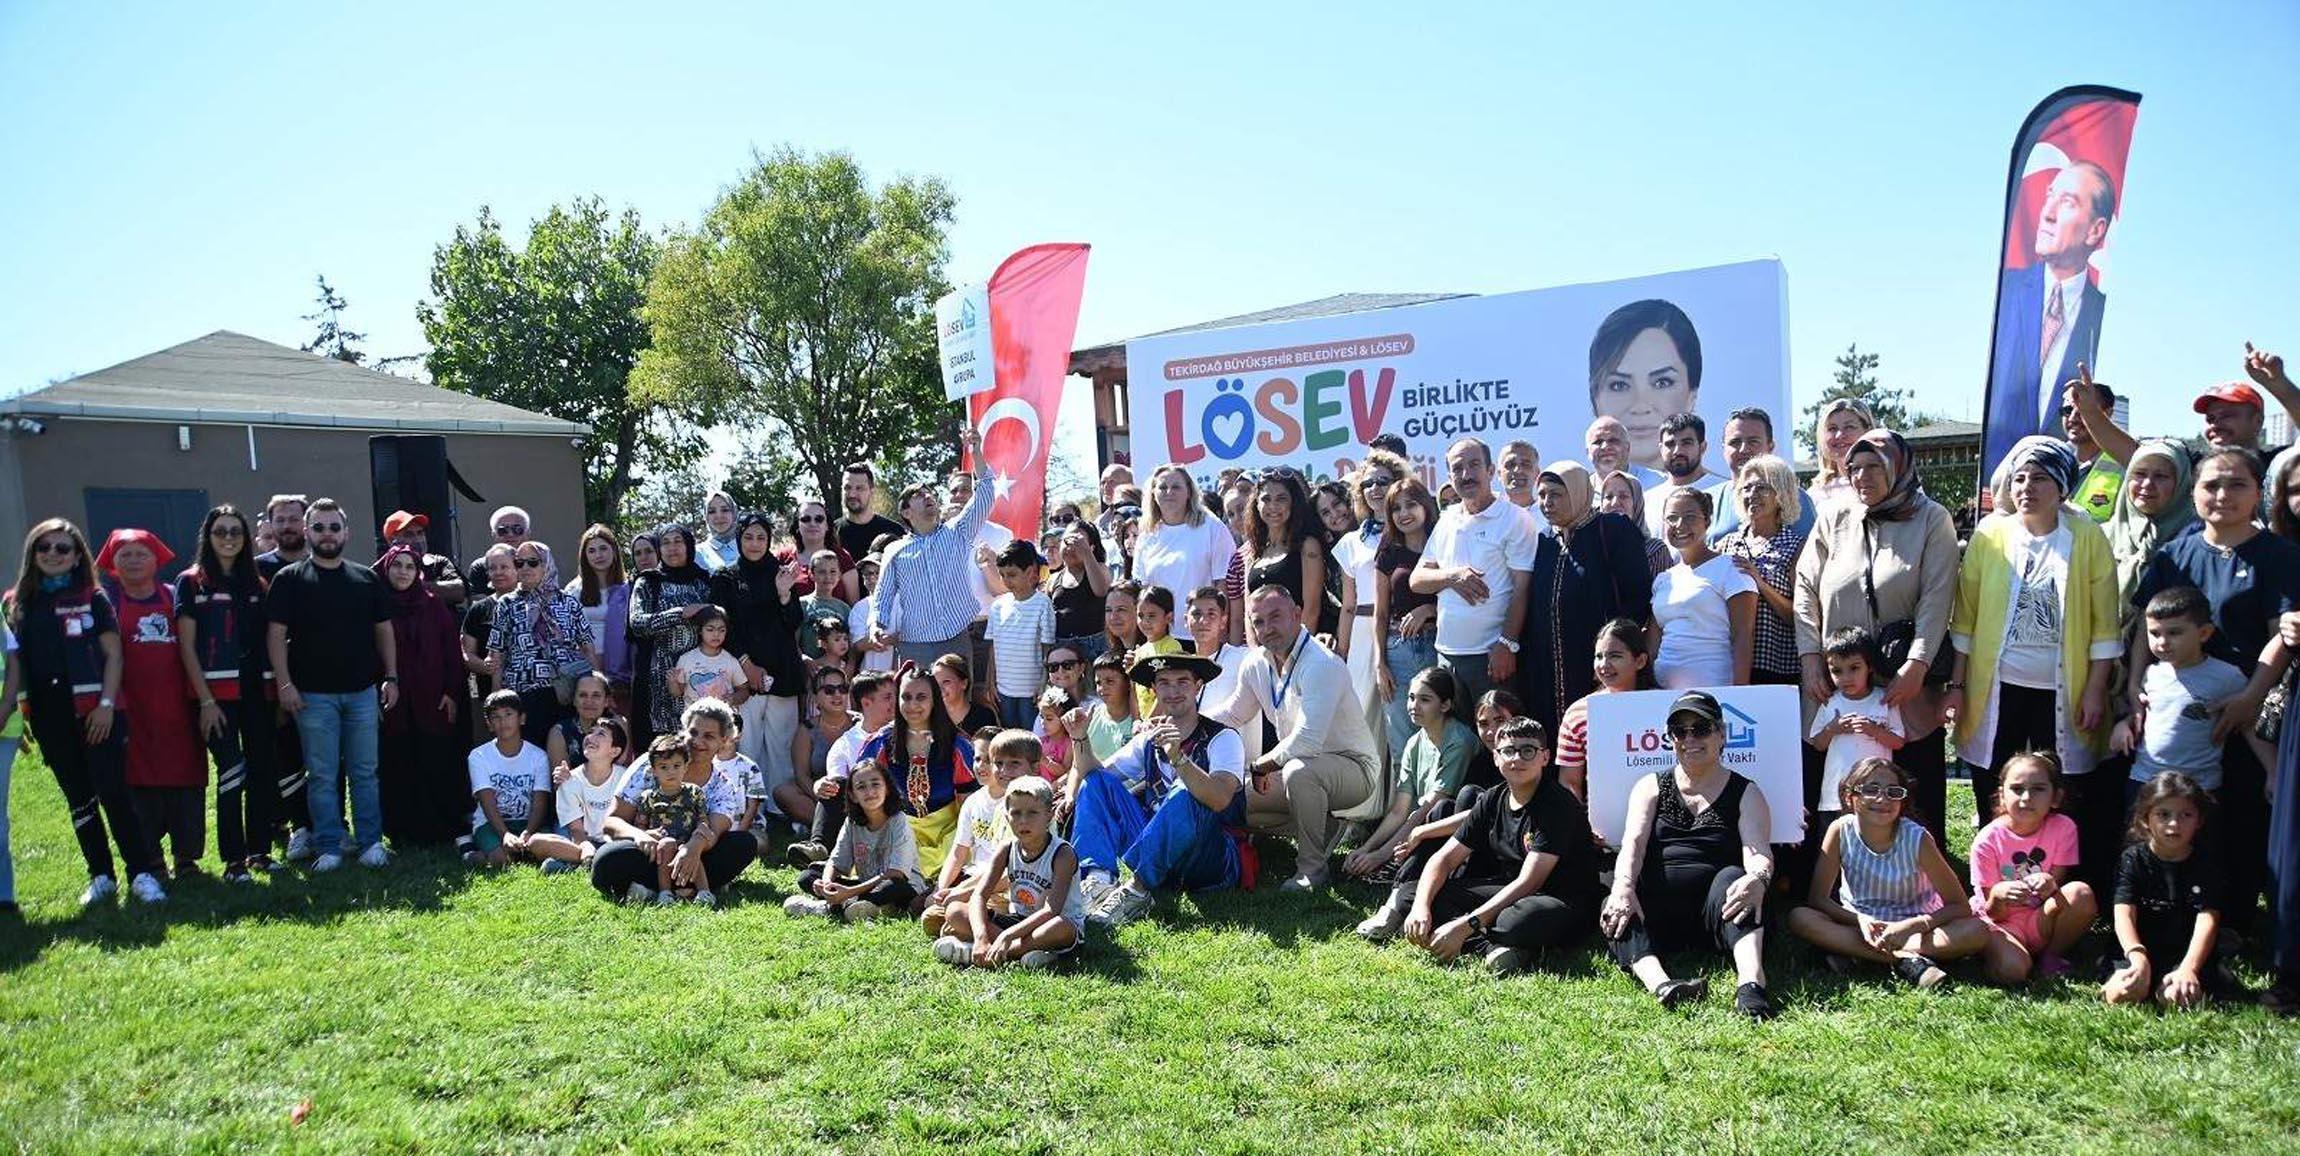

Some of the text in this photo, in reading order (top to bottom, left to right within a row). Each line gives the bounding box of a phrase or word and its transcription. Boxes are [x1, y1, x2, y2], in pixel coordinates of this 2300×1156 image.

[1169, 341, 1409, 377] TEKİRDAĞ BÜYÜKŞEHİR BELEDİYESİ & LÖSEV
[1403, 379, 1509, 408] BİRLİKTE
[1164, 368, 1396, 465] LÖSEV
[1404, 404, 1539, 439] GÜÇLÜYÜZ
[1626, 729, 1673, 752] LÖS
[1626, 755, 1673, 767] Lösemili
[1727, 752, 1756, 764] Vakfı
